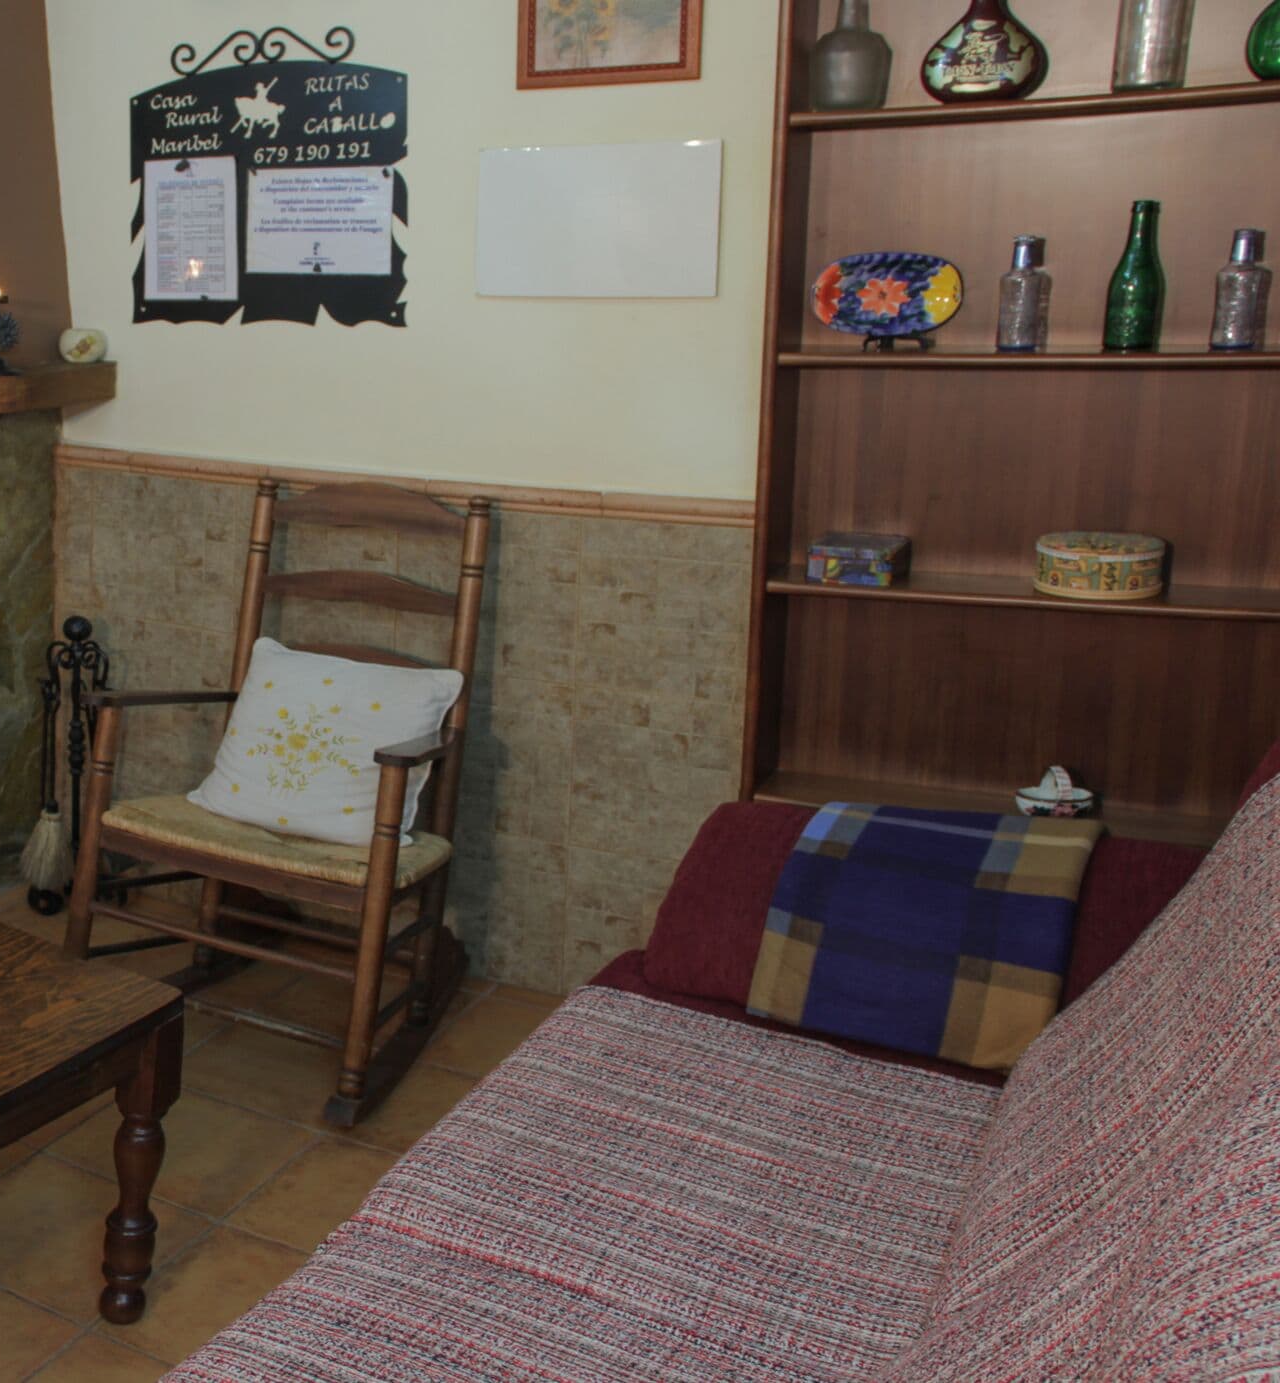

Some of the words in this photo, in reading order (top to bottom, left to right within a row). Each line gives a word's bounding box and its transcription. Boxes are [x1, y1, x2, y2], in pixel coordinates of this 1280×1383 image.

[305, 73, 370, 95] RUTAS
[150, 93, 198, 110] Casa
[328, 95, 342, 112] A
[165, 106, 223, 129] Rural
[303, 112, 396, 134] CABALLO
[150, 133, 223, 155] Maribel
[253, 147, 288, 164] 679
[294, 144, 330, 162] 190
[336, 141, 371, 160] 191
